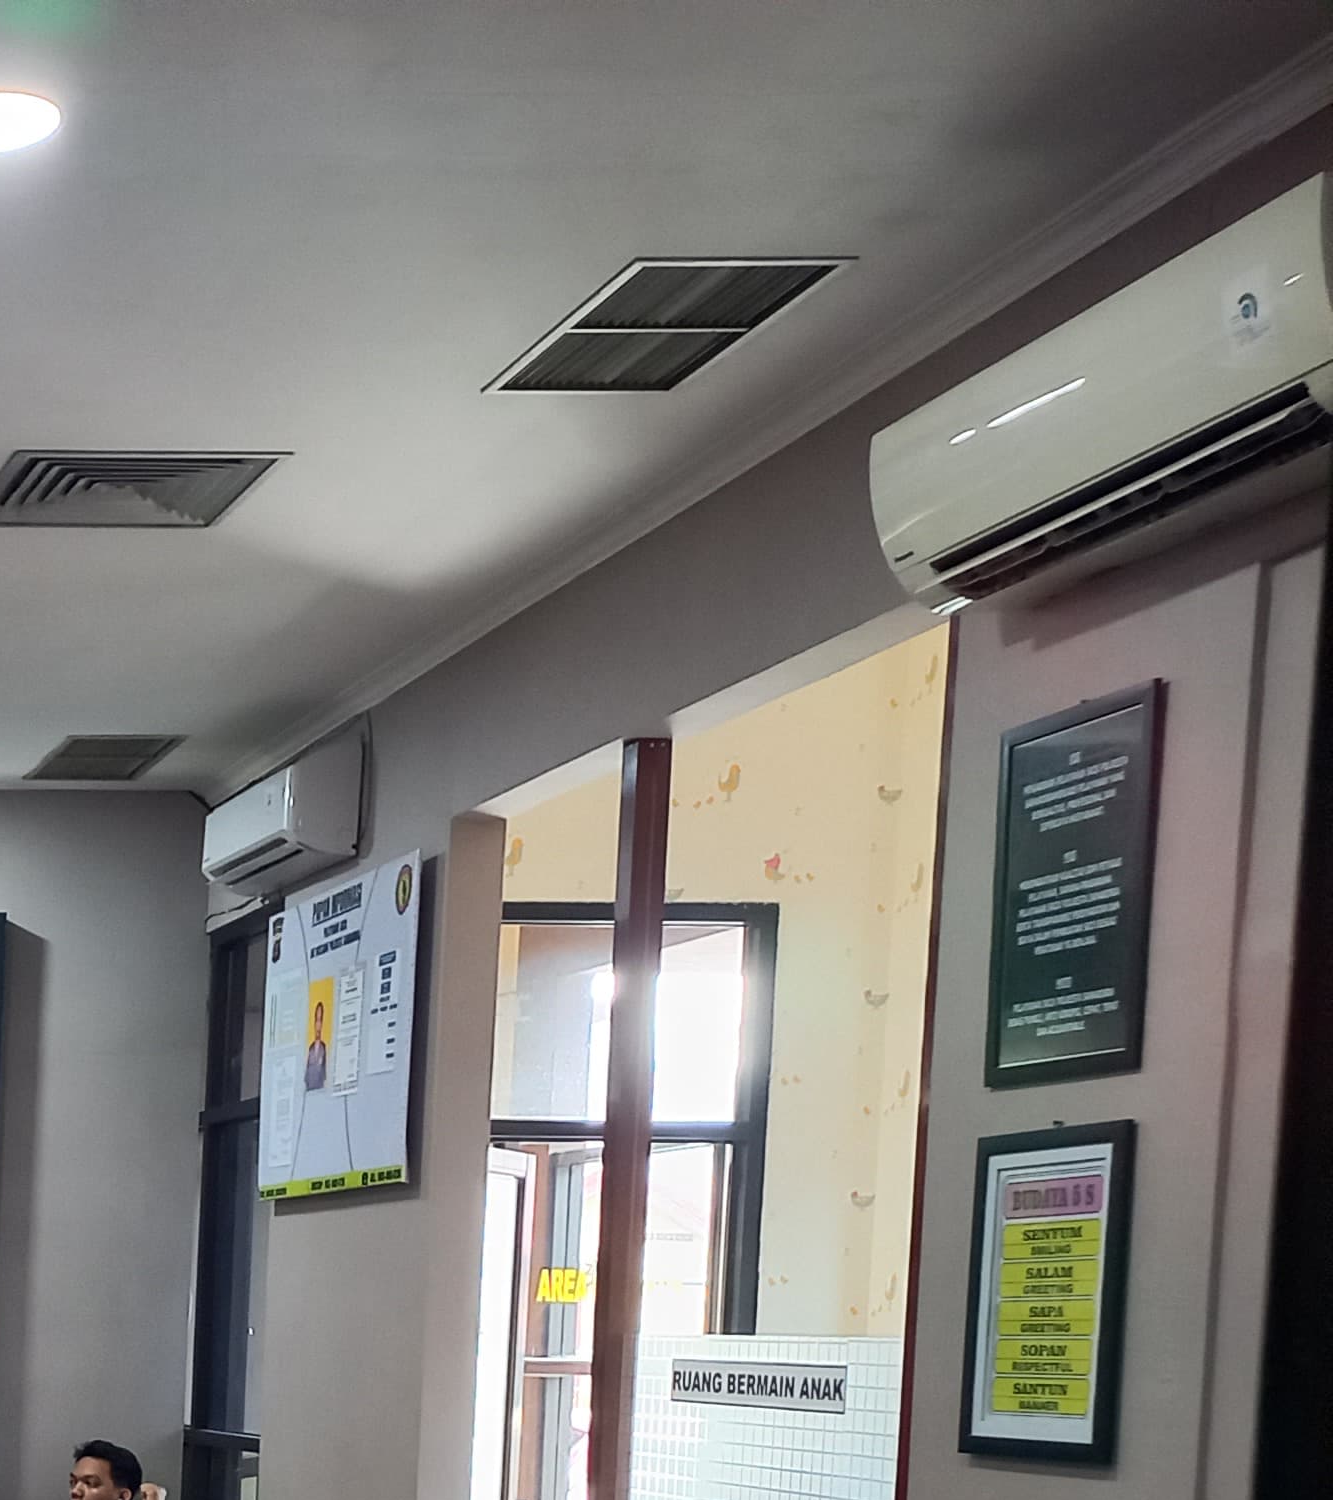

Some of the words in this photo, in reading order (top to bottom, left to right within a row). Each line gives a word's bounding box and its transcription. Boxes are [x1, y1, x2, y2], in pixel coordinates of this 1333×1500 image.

[1085, 1183, 1096, 1206] S
[1025, 1266, 1073, 1280] SALAM
[535, 1267, 587, 1303] AREA
[1028, 1305, 1065, 1318] SAPA
[1020, 1344, 1068, 1357] SOPAN
[672, 1369, 723, 1394] RUANG
[726, 1373, 796, 1399] BERMAIN
[799, 1376, 845, 1401] ANAK
[1013, 1382, 1069, 1396] SANTUN
